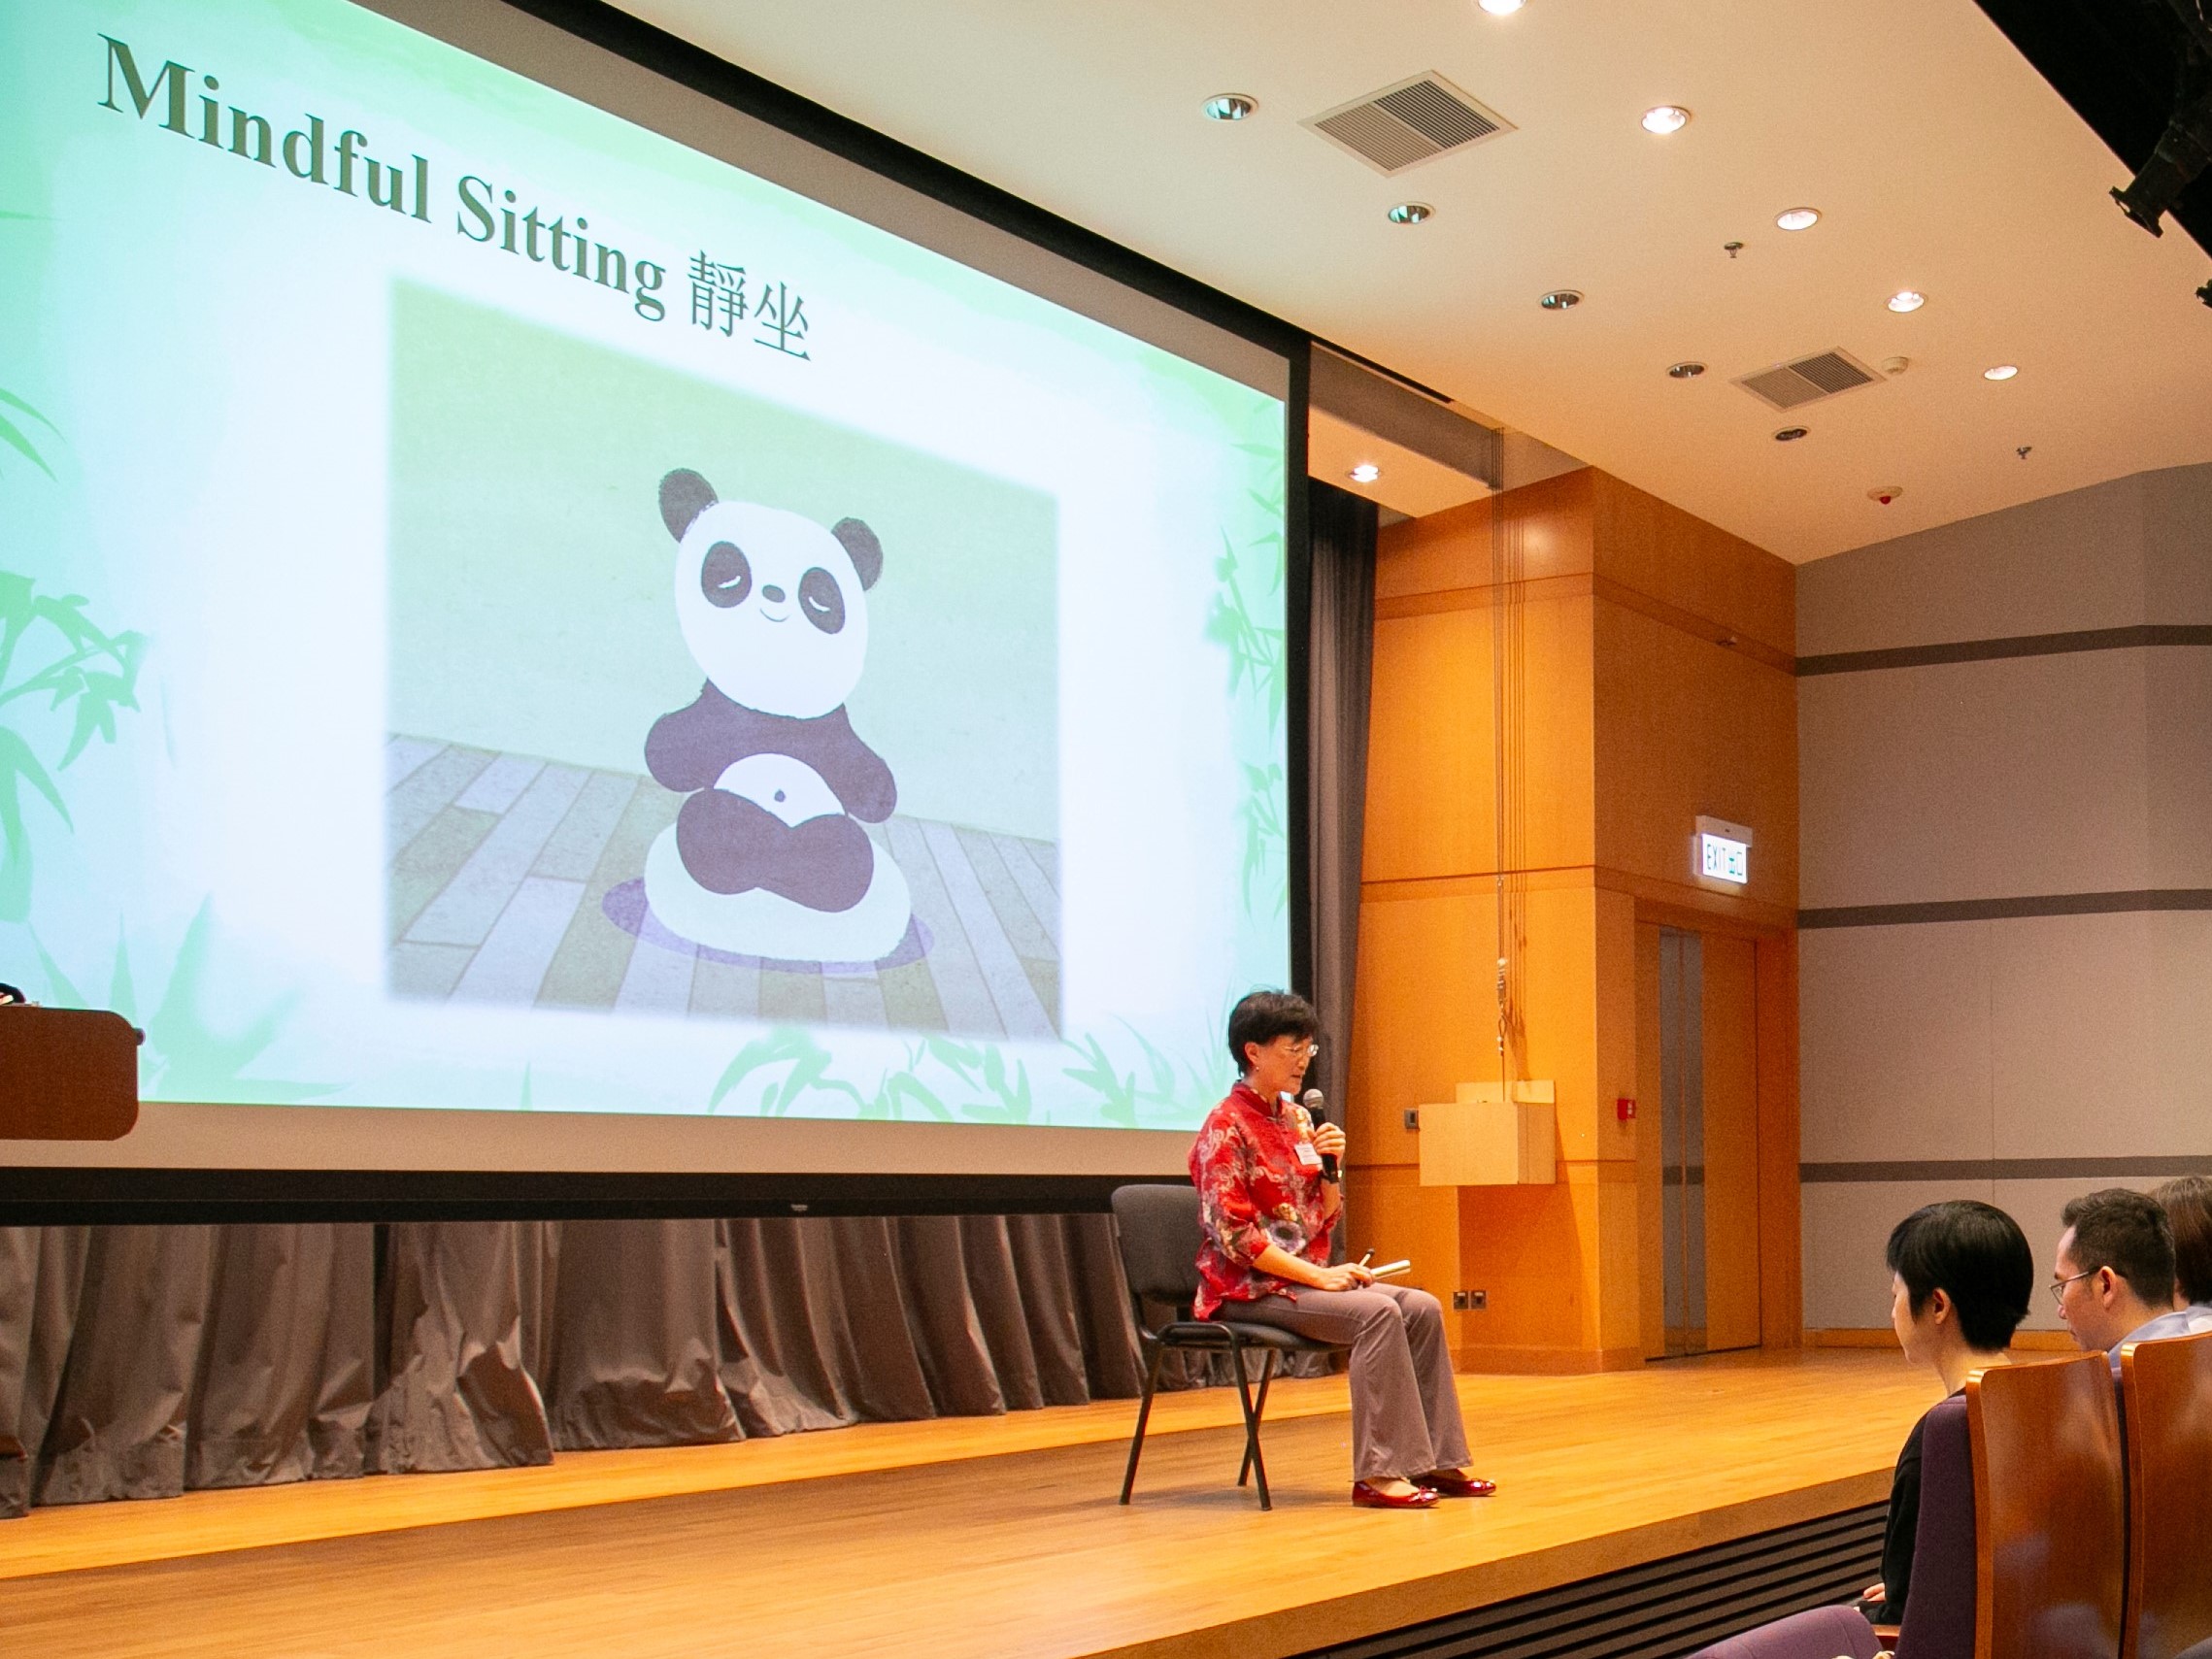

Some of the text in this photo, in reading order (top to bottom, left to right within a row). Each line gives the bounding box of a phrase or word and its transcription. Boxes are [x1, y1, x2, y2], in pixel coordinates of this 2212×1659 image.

[97, 32, 812, 362] Mindful Sitting 靜坐
[1706, 843, 1726, 872] EXIT
